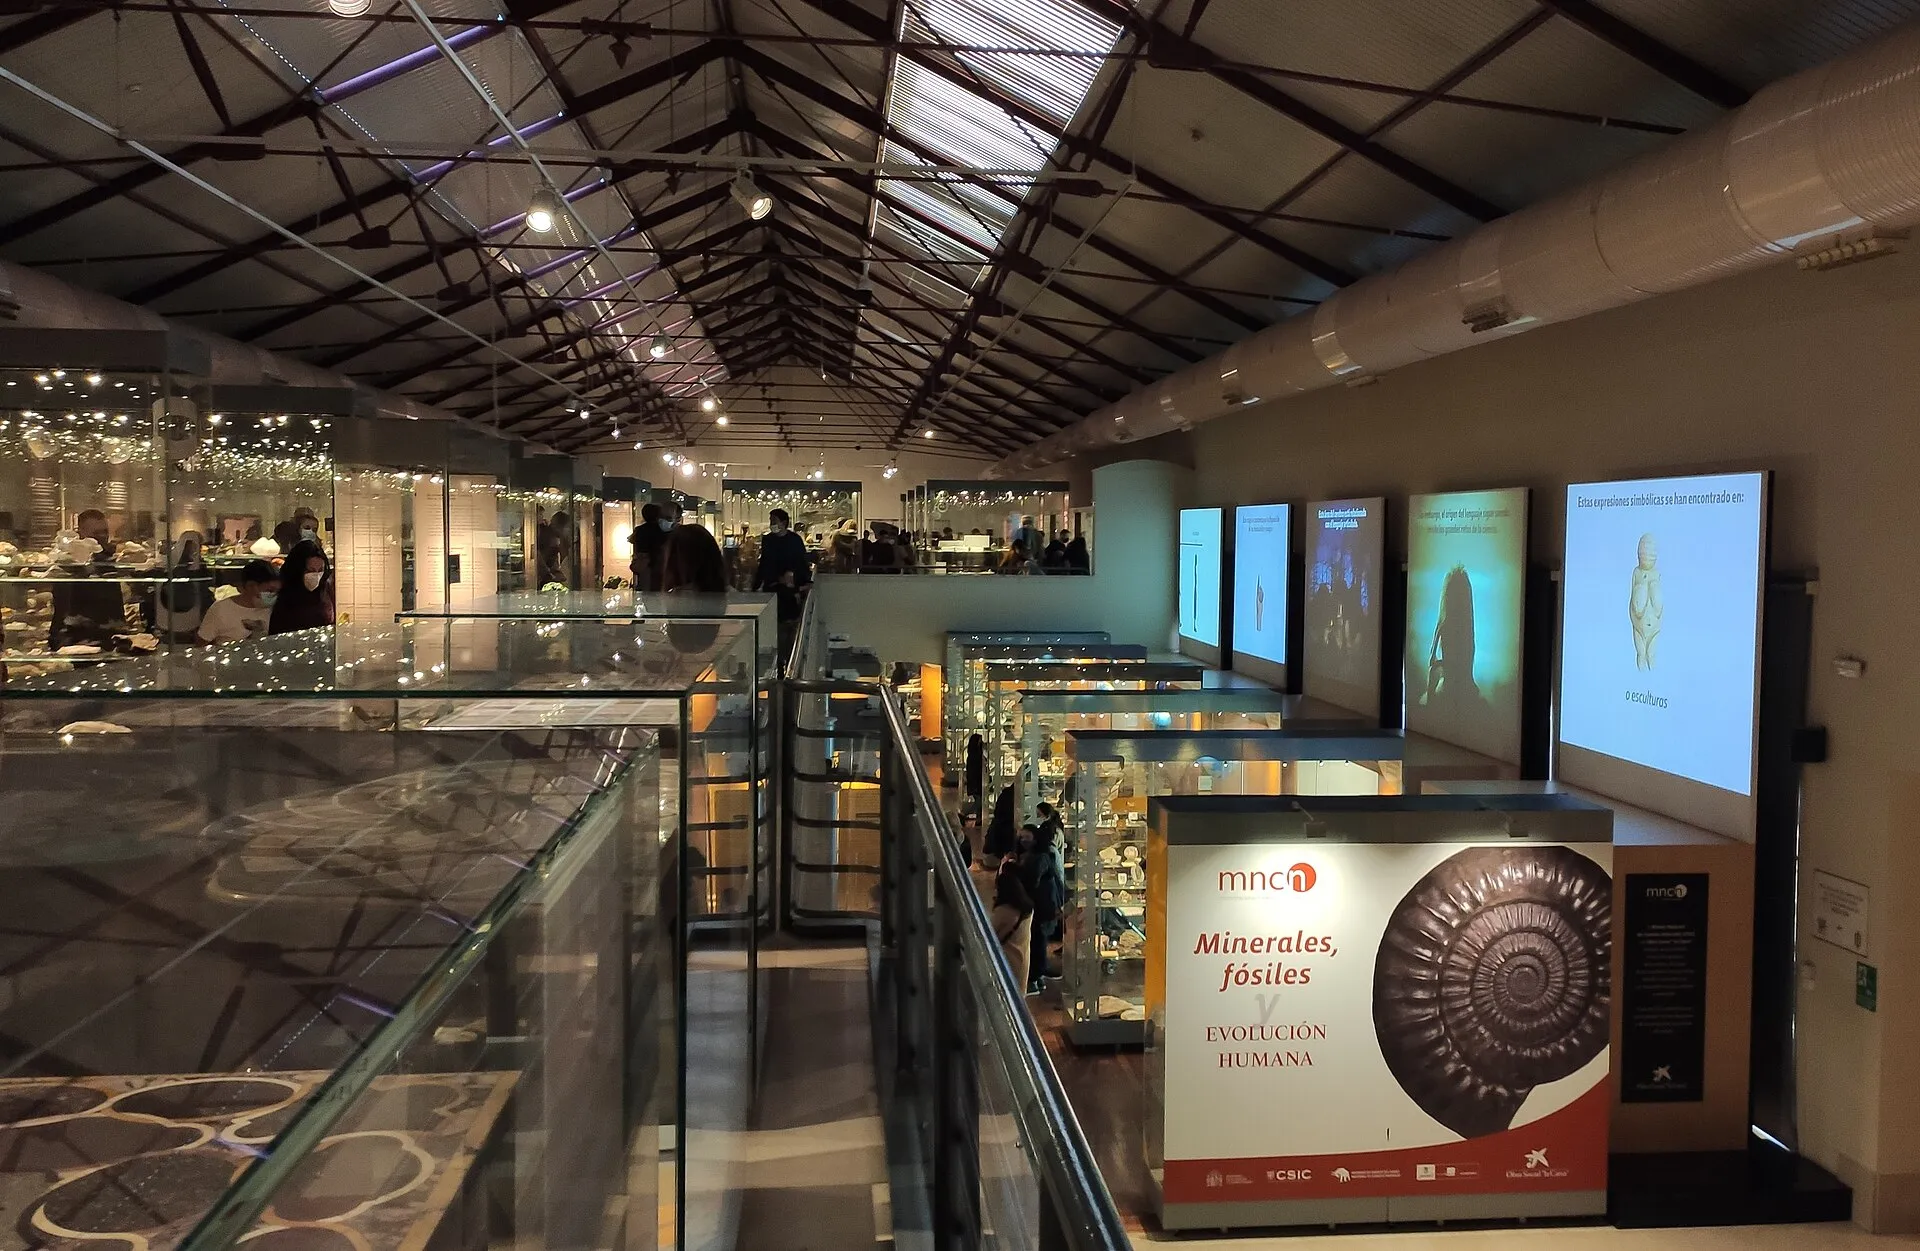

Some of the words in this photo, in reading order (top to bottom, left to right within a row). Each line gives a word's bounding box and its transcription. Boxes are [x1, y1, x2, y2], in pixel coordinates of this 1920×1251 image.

[1577, 496, 1593, 508] Estas
[1594, 494, 1630, 510] expresiones
[1630, 492, 1665, 507] simbólicas
[1665, 495, 1673, 505] se
[1674, 491, 1687, 505] han
[1688, 489, 1731, 504] encontrado
[1731, 492, 1744, 504] en:
[1219, 862, 1317, 893] mncn
[1194, 930, 1338, 957] Minerales,
[1219, 962, 1311, 992] fósiles
[1254, 993, 1281, 1029] y
[1206, 1020, 1328, 1042] EVOLUCIÓN
[1218, 1050, 1314, 1068] HUMANA
[1275, 1169, 1313, 1180] CSIC
